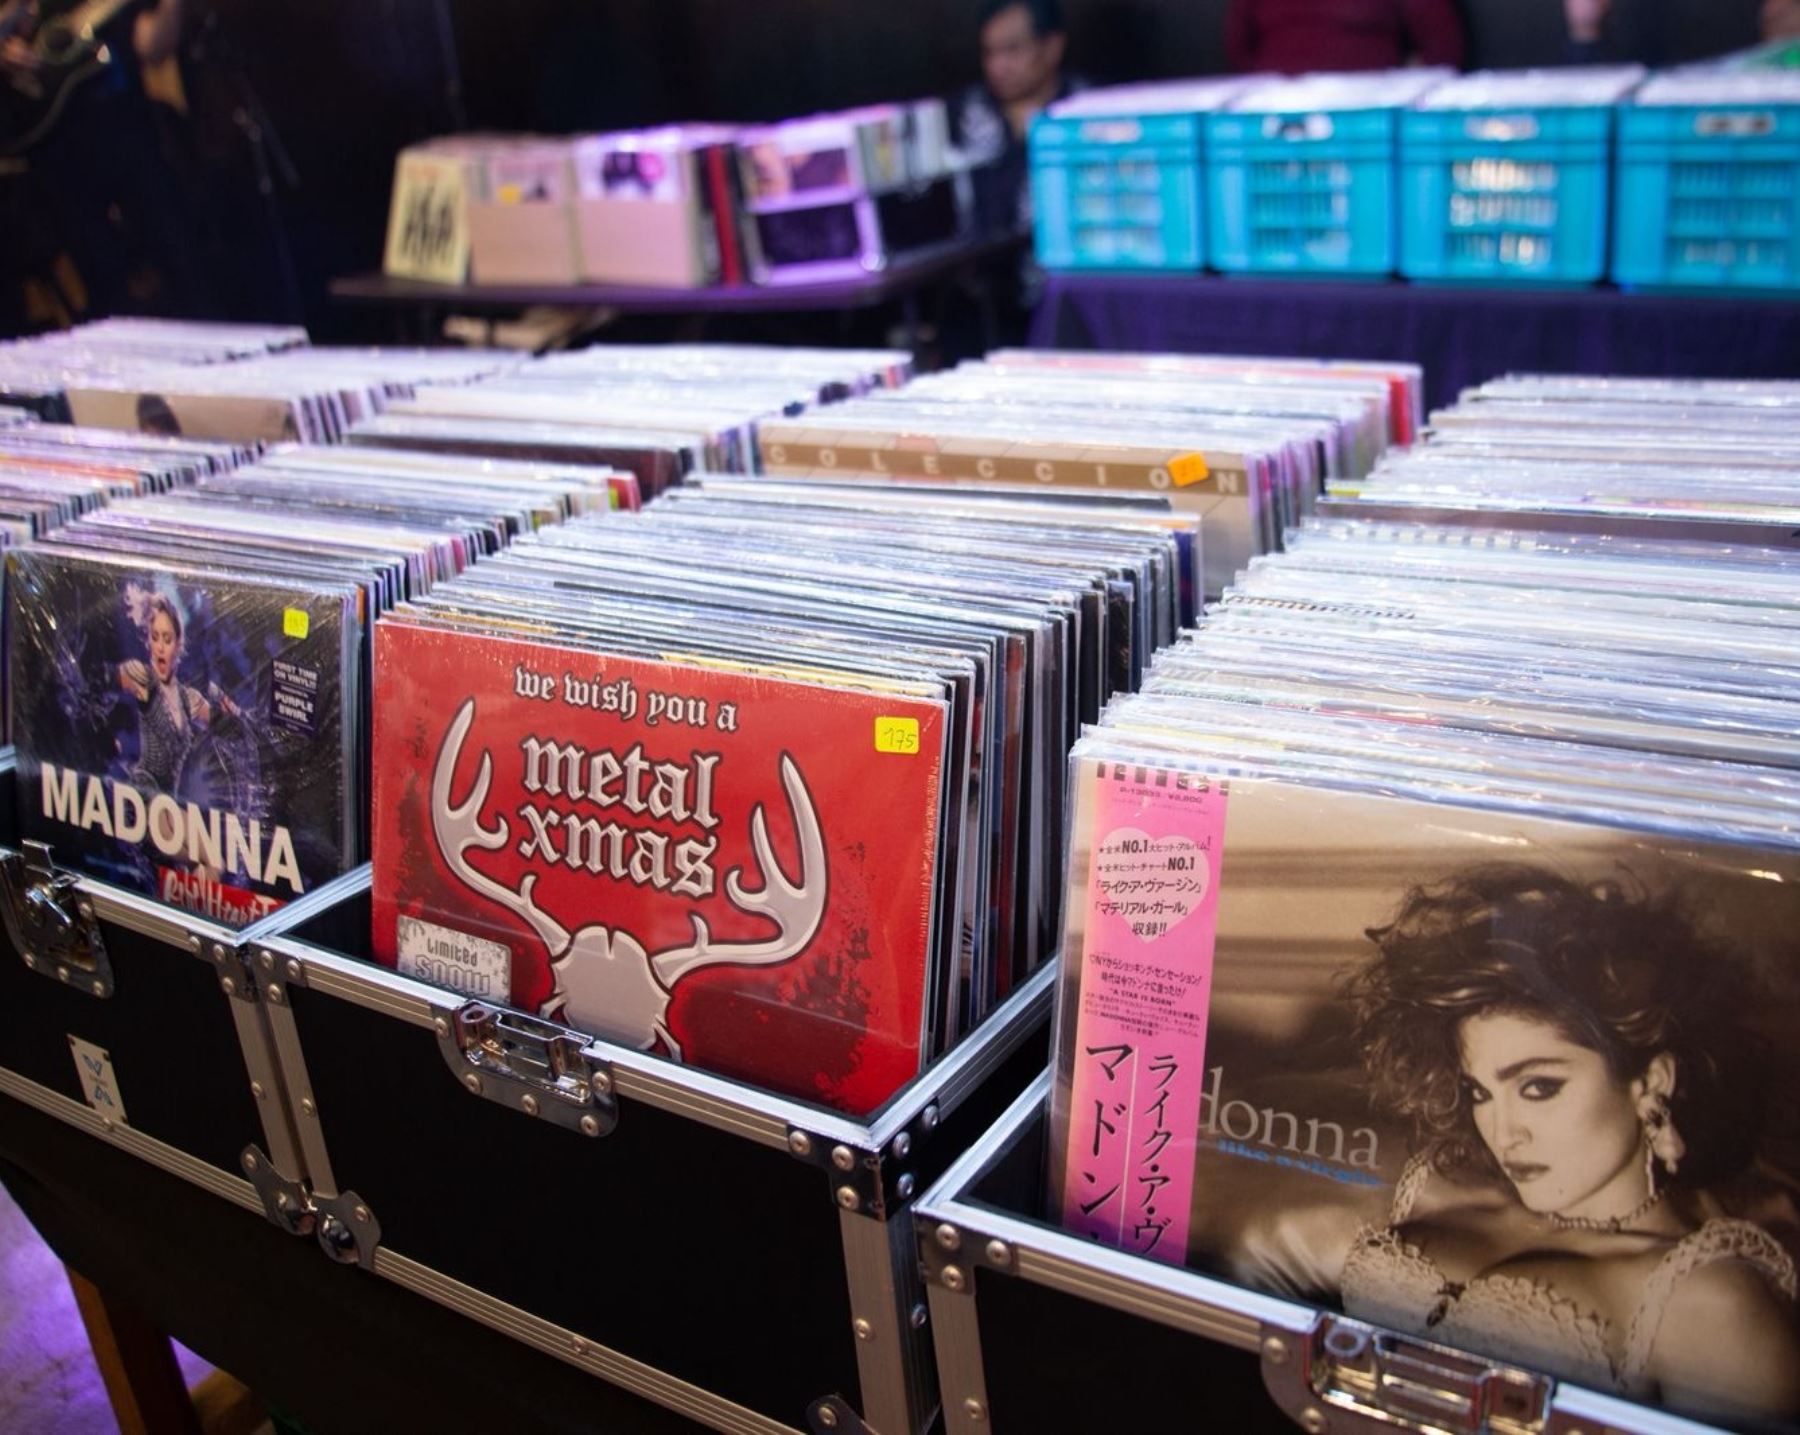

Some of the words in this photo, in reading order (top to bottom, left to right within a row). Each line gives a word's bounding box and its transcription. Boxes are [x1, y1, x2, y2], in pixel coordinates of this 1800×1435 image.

[515, 666, 554, 700] we
[564, 674, 638, 720] wish
[647, 690, 709, 727] you
[716, 701, 738, 731] a
[884, 727, 917, 751] 175
[41, 762, 305, 894] MADONNA
[522, 736, 720, 829] metal
[517, 802, 718, 897] xmas
